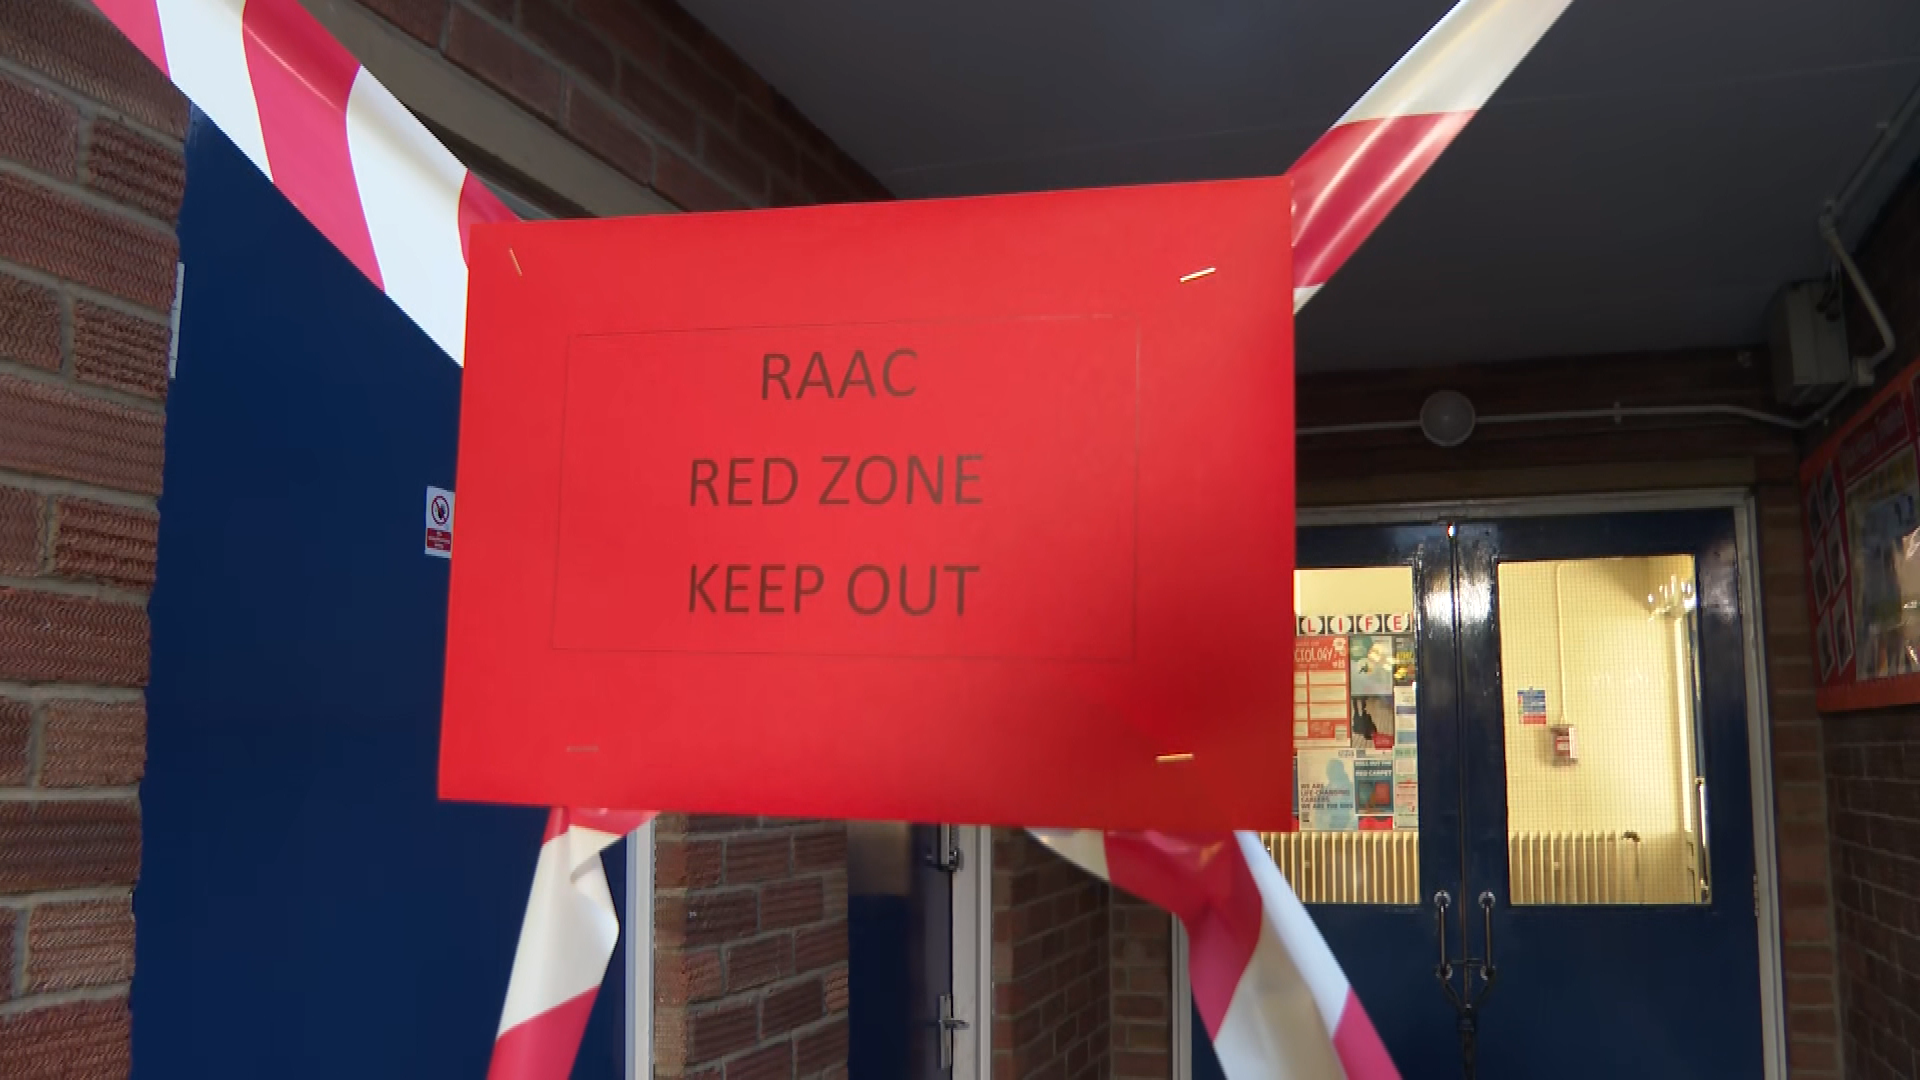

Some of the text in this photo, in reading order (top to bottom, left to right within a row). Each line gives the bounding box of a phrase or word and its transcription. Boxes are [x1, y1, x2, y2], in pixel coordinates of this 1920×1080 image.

[761, 348, 918, 400] RAAC
[689, 454, 984, 506] RED ZONE
[689, 563, 980, 616] KEEP OUT
